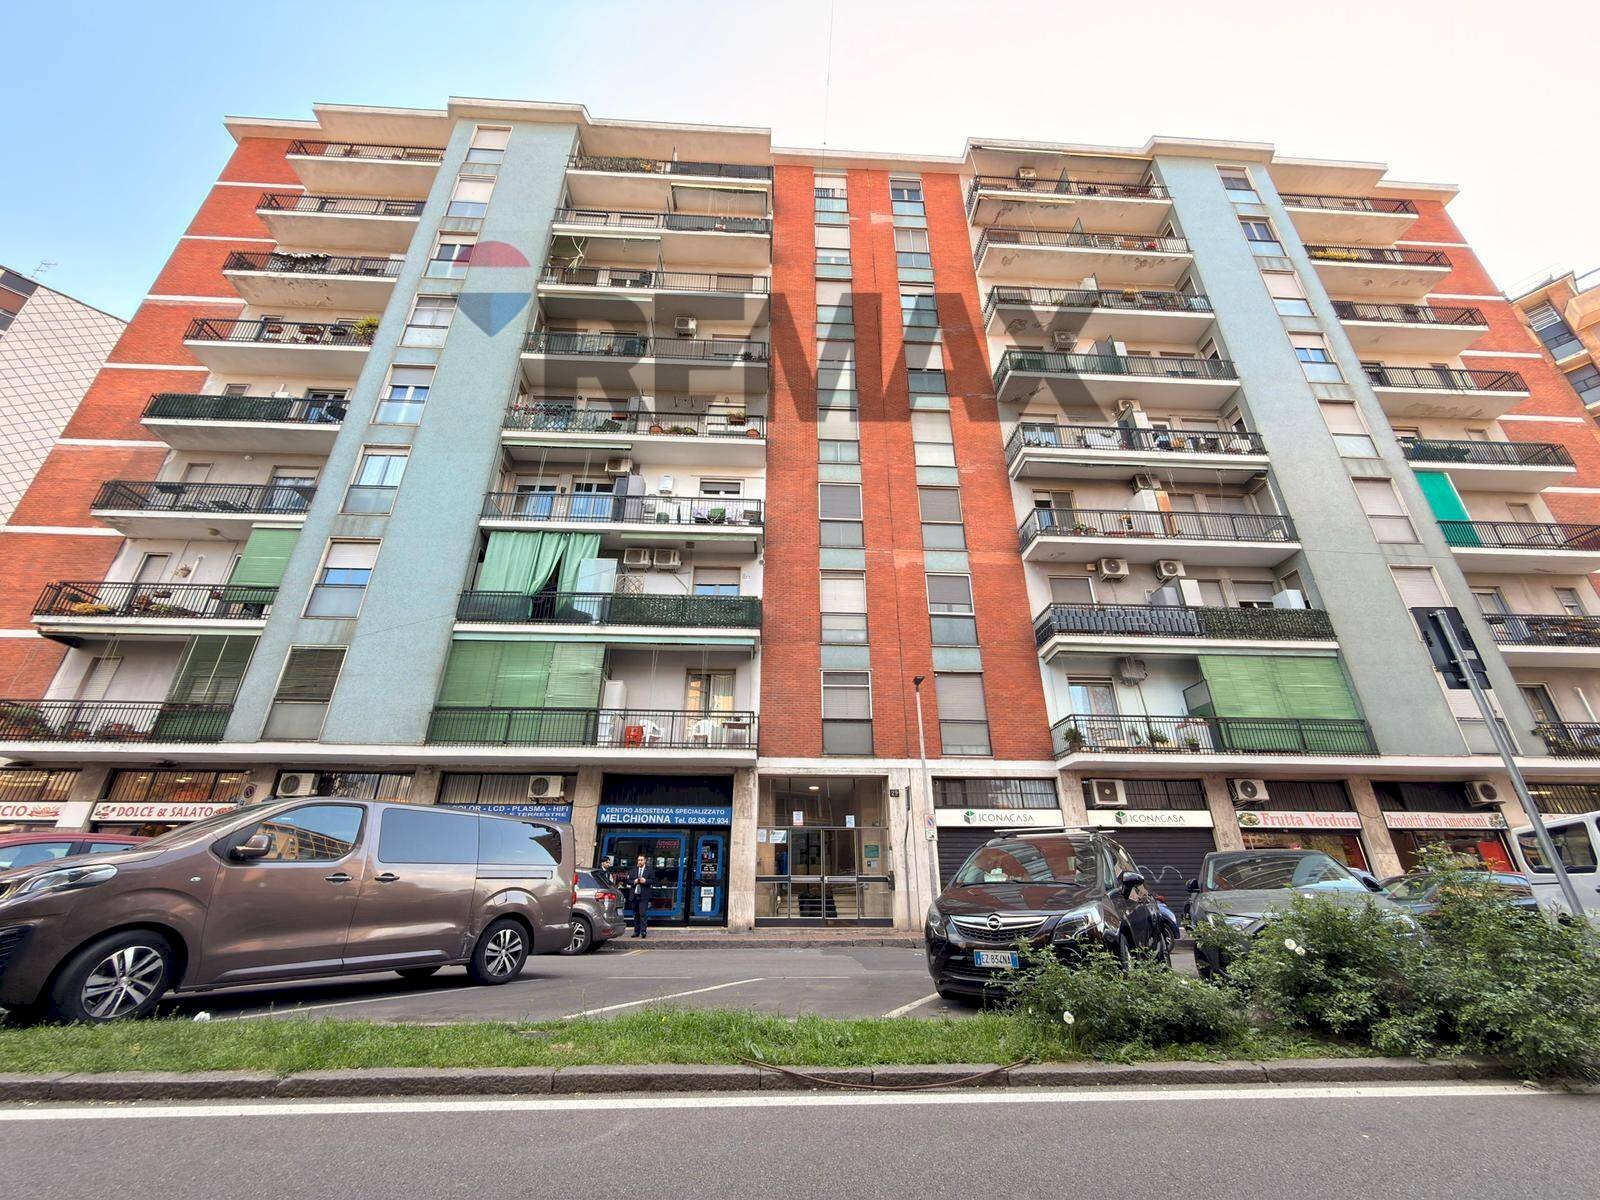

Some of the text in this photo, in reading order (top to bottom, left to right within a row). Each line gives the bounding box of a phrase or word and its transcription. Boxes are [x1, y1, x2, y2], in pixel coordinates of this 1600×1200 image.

[0, 805, 28, 817] CIO
[116, 806, 214, 817] DOLCE & SALATO
[634, 807, 674, 815] ASSISTENZA
[600, 813, 671, 824] MELCHIONNA
[674, 816, 686, 824] Tel.
[978, 813, 1035, 823] ICONACASA
[1129, 814, 1186, 823] ICONACASA
[1260, 812, 1361, 828] Frutta Verdura
[1385, 814, 1488, 828] Prodotti afro Americani
